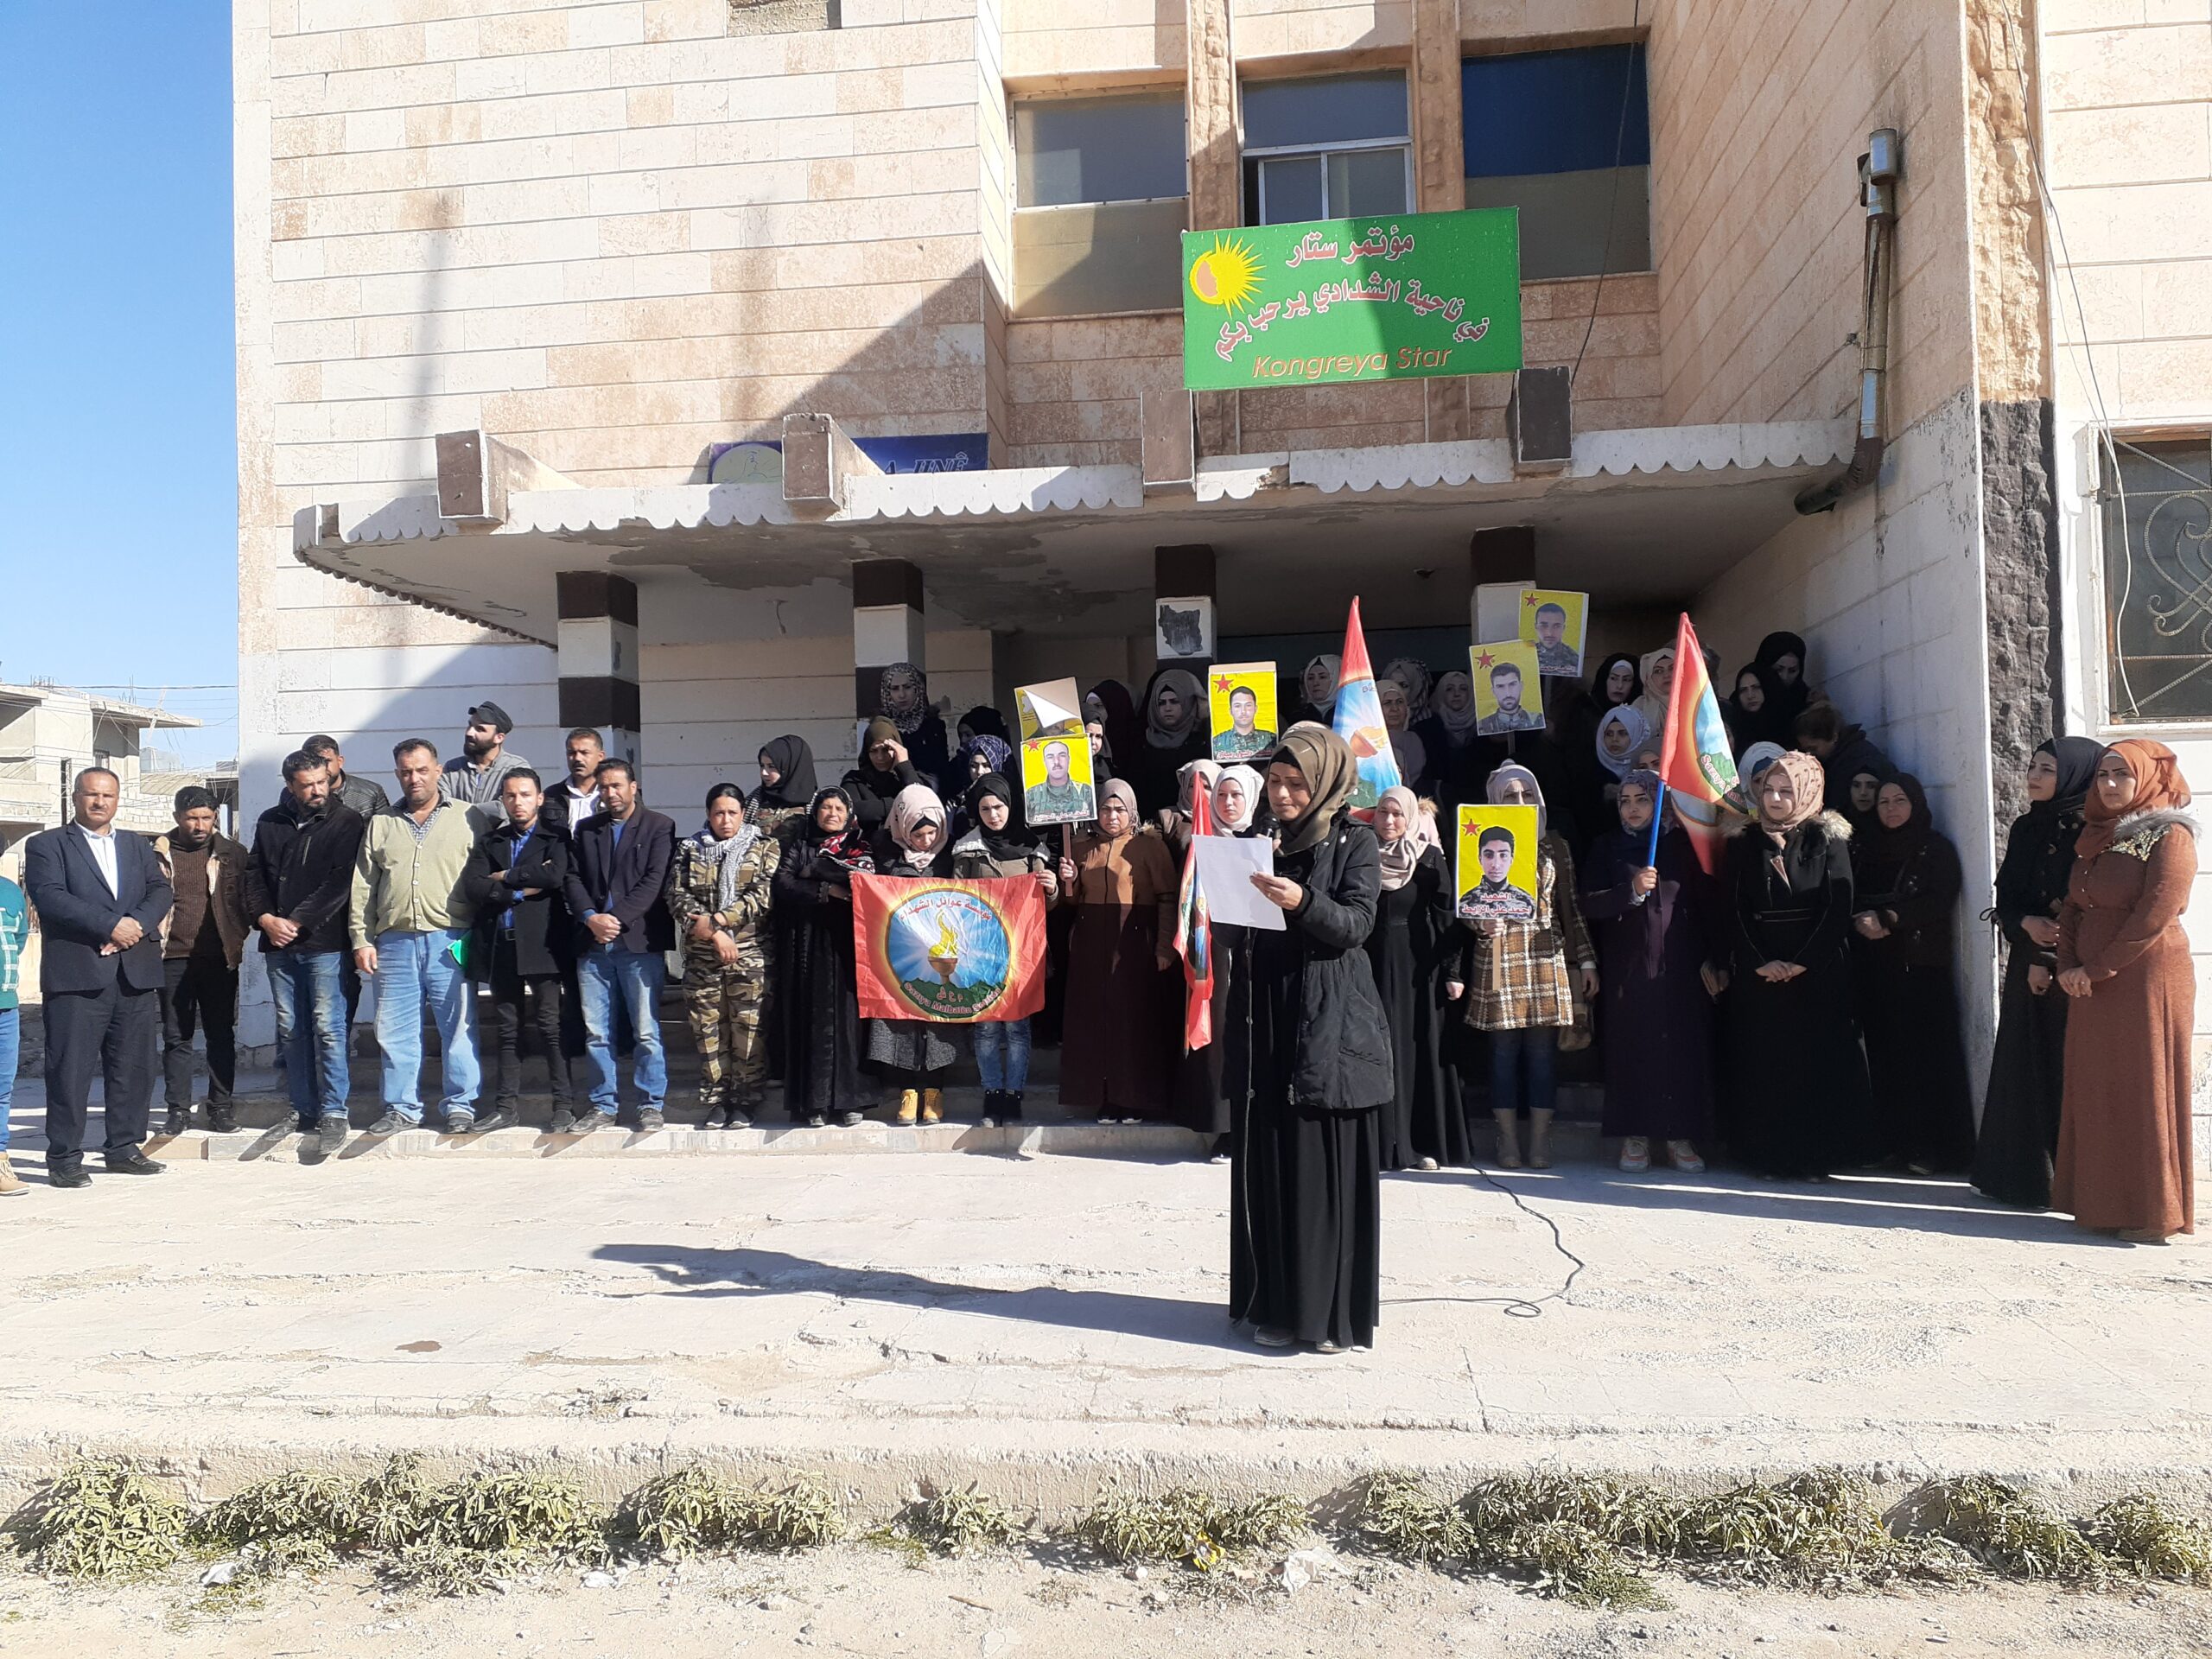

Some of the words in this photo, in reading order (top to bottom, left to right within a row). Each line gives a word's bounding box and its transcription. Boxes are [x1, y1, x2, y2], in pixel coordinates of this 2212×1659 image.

[1286, 232, 1338, 268] ستار
[1341, 225, 1414, 264] مؤتمر
[1248, 290, 1311, 332] يرحب
[1313, 271, 1401, 314] الشدادي
[1404, 278, 1465, 322] ناحية
[1215, 321, 1253, 362] بكم
[1453, 317, 1490, 342] في
[1252, 353, 1389, 379] Kongreya
[1395, 346, 1452, 370] Star
[1480, 892, 1511, 903] الشهيد
